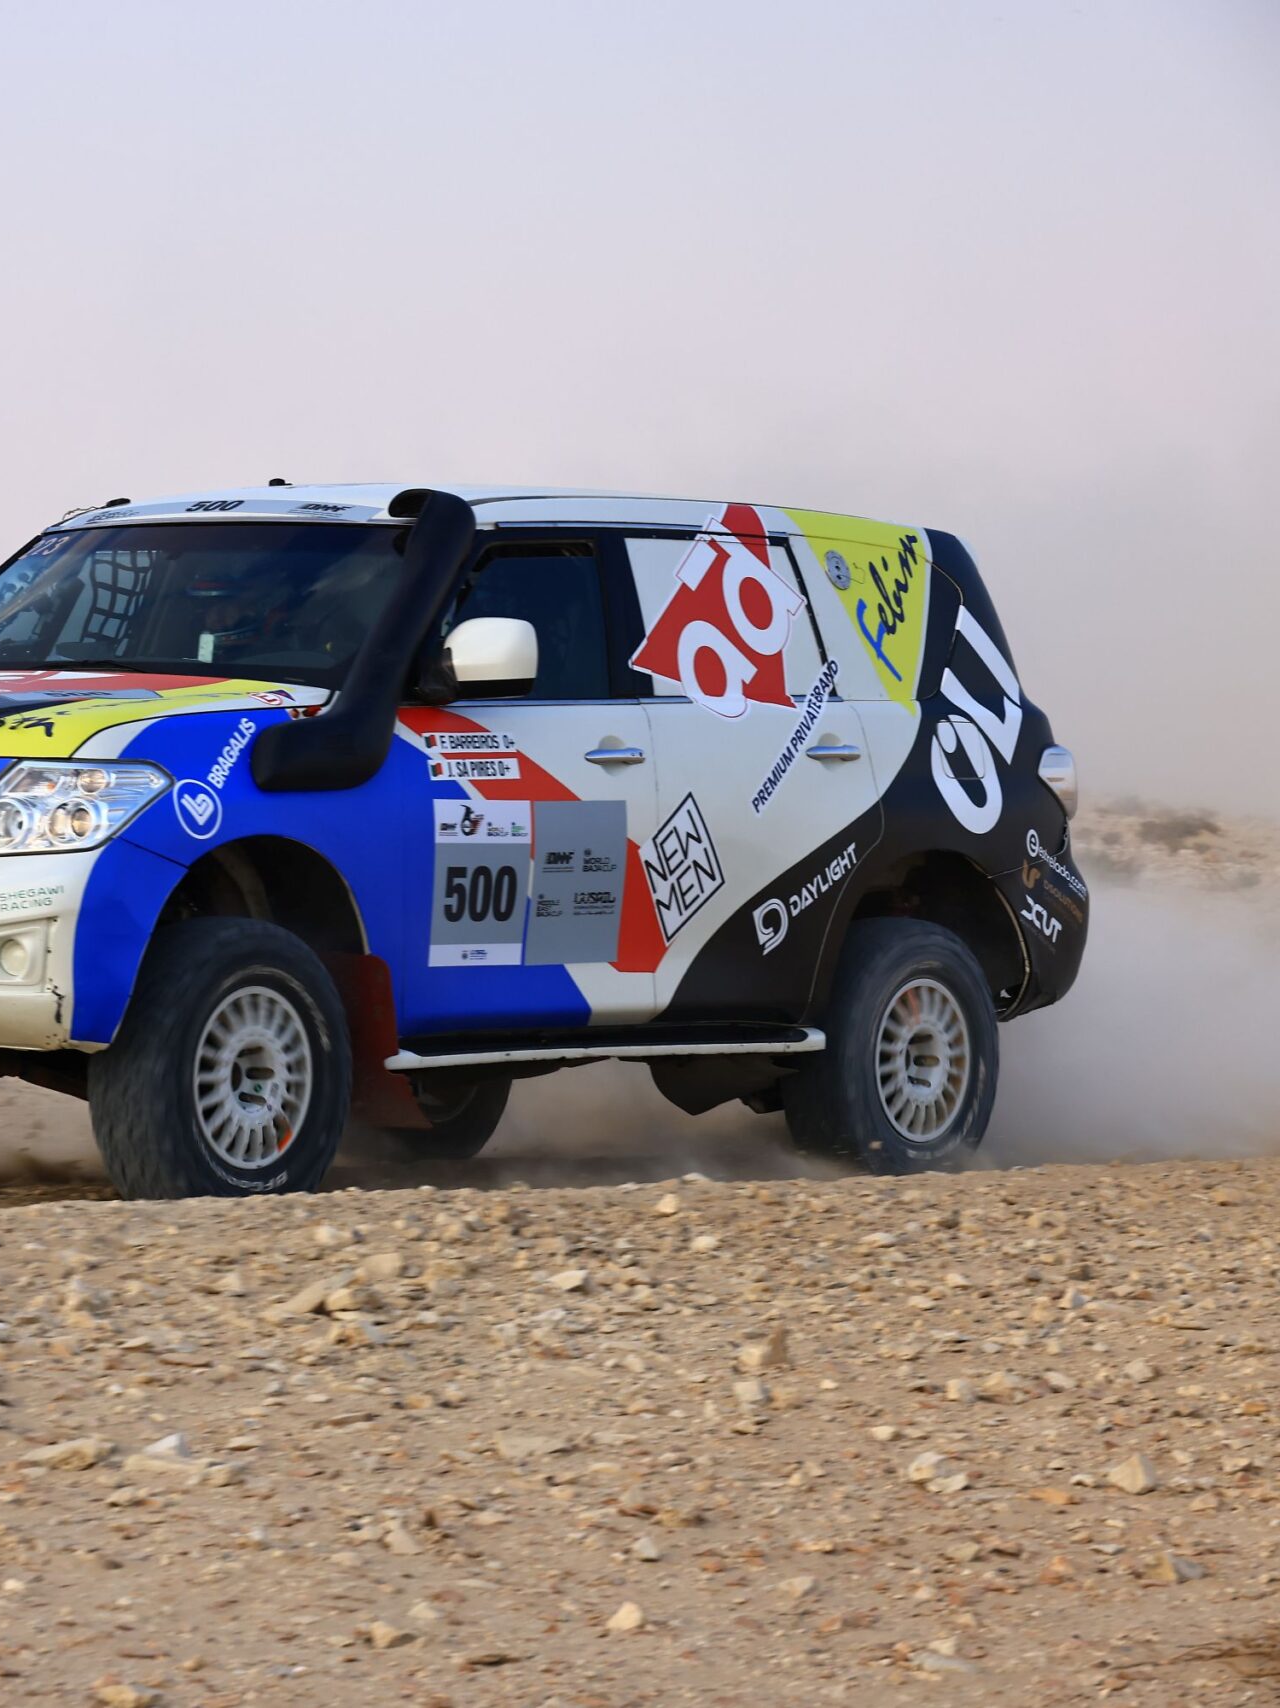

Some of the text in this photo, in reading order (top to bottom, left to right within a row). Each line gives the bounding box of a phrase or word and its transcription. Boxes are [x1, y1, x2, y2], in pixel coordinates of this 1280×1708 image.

[185, 500, 245, 512] 500
[207, 717, 257, 789] BRAGALIS
[449, 734, 500, 749] BARREIROS
[752, 659, 839, 814] PREMIUM PRIVATE BRAND
[930, 604, 1023, 834] OLI
[469, 760, 497, 777] PIRES
[644, 809, 703, 894] NEW
[655, 847, 717, 916] MEN
[789, 842, 858, 917] DAYLIGHT
[0, 897, 53, 912] RACING
[443, 865, 518, 922] 500
